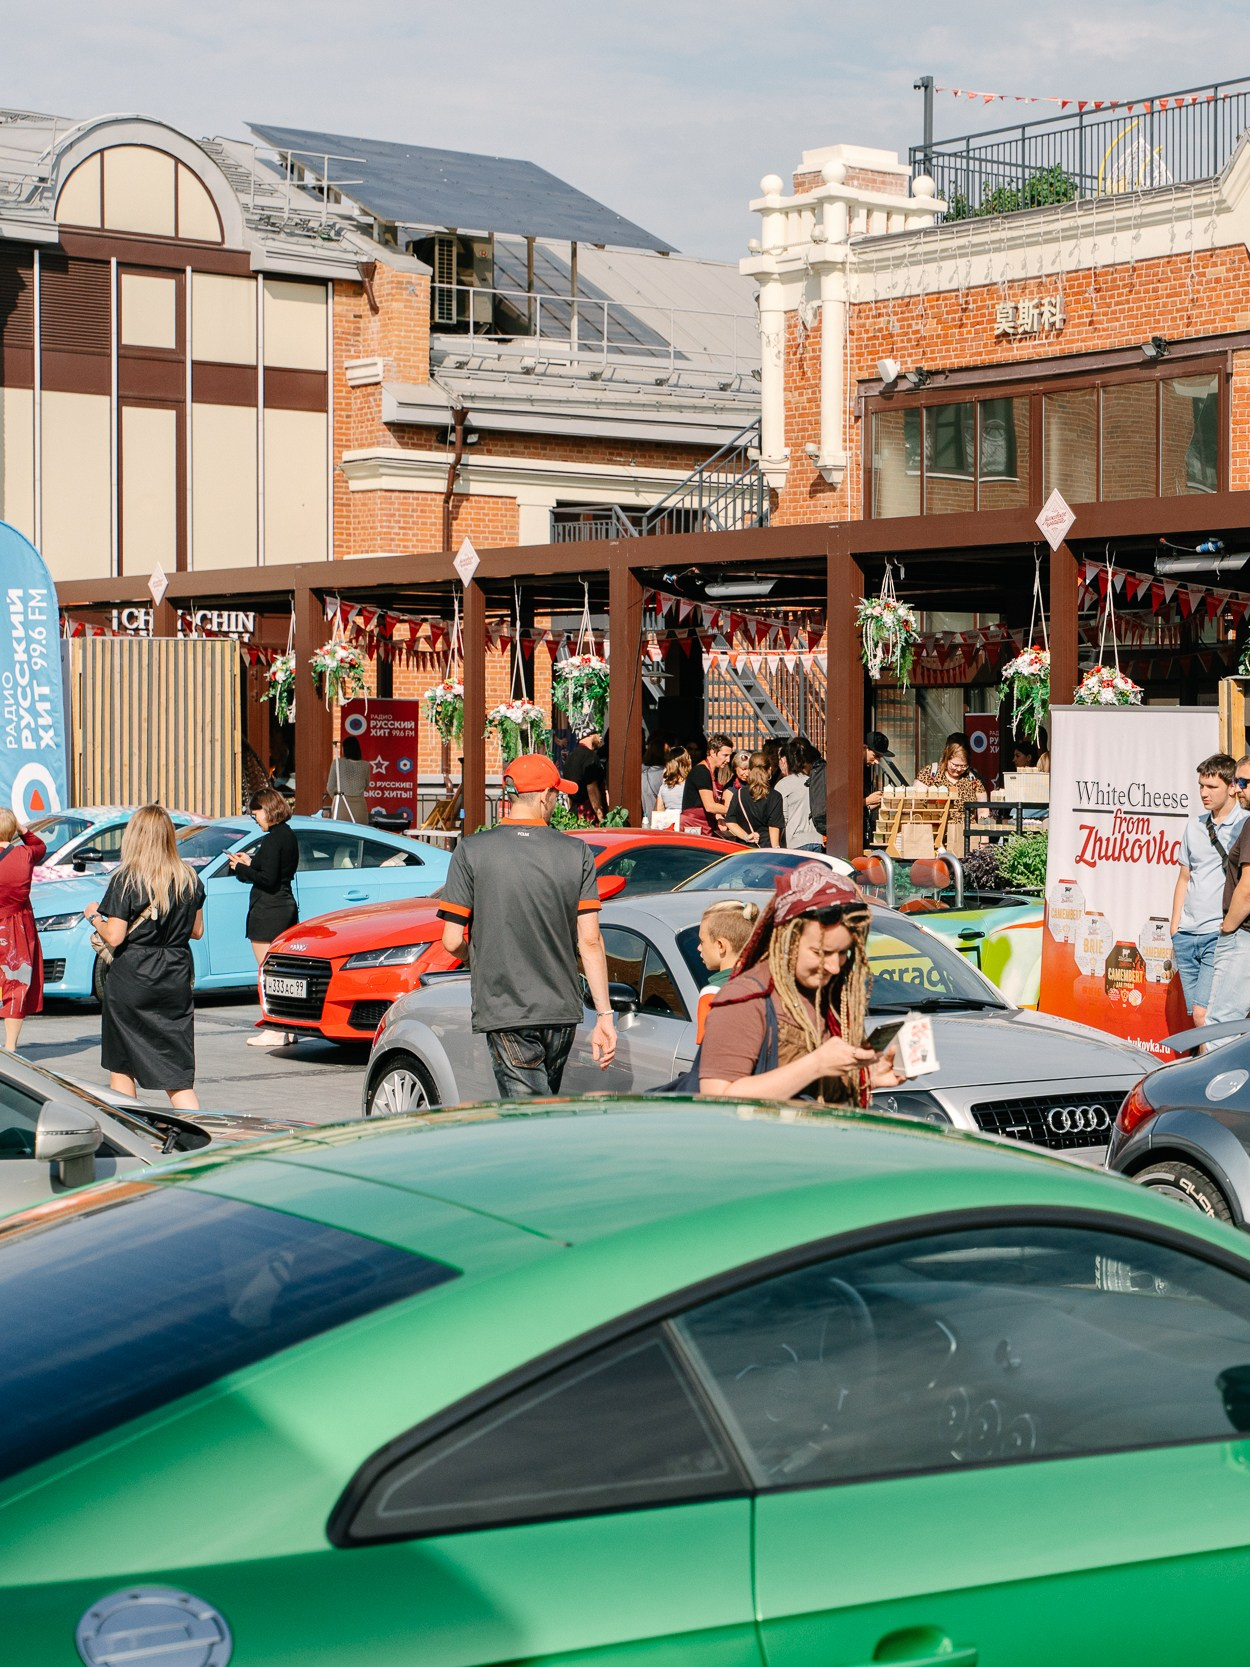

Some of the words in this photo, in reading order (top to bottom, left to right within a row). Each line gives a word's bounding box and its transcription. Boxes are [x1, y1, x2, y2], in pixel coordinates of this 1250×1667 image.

[994, 295, 1067, 335] 莫斯科
[28, 589, 48, 620] FM
[28, 626, 48, 671] 99.6
[6, 588, 38, 750] РУССКИЙ
[2, 671, 18, 749] РАДИО
[32, 680, 57, 750] ХИТ
[370, 719, 415, 729] РУССКИЙ
[370, 729, 390, 737] ХИТ
[1112, 808, 1151, 837] from
[1083, 938, 1104, 954] BRIE
[1107, 968, 1144, 983] CAMEMBERT
